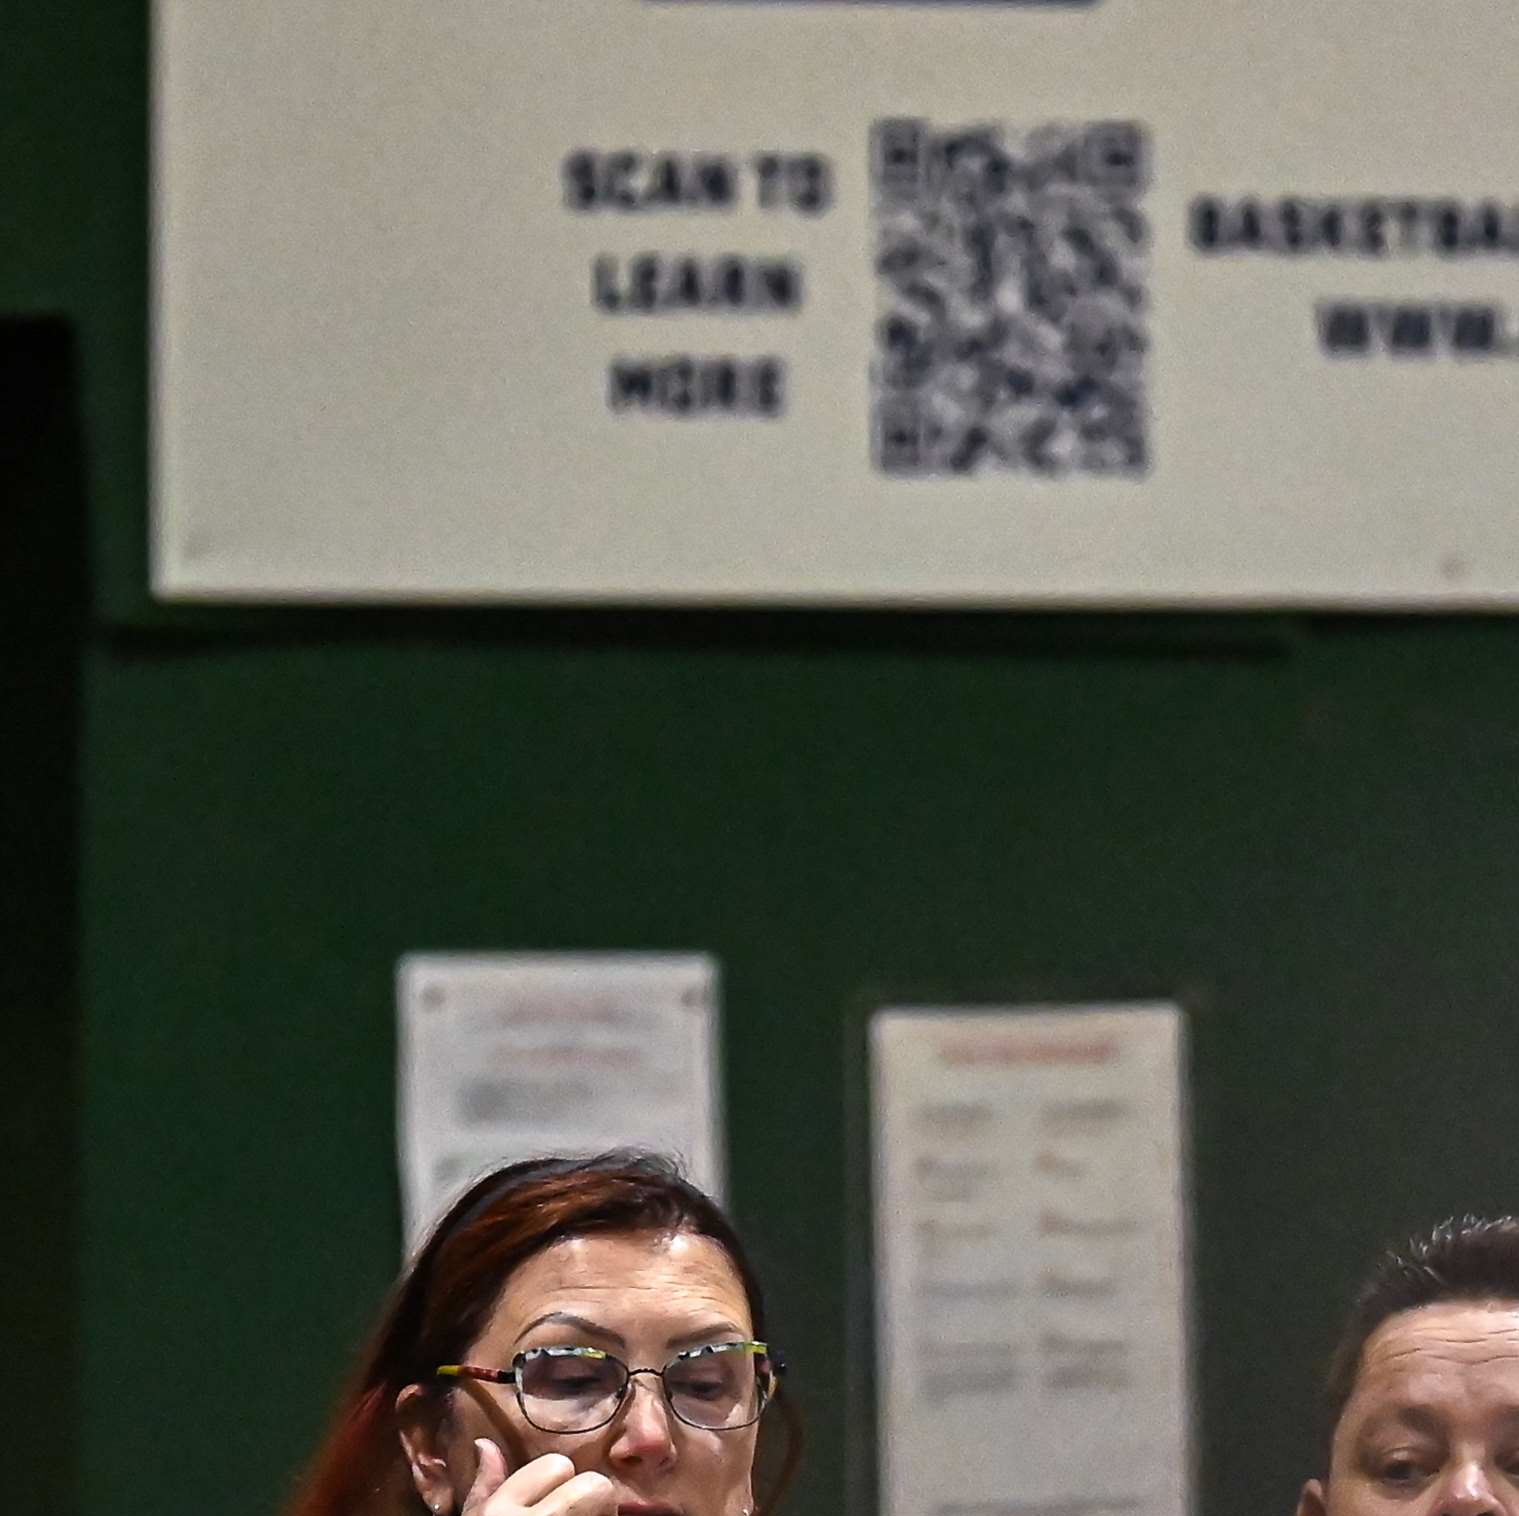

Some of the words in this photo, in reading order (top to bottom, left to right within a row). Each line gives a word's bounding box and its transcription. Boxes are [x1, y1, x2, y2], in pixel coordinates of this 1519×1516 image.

[563, 150, 737, 212] SCAN
[751, 152, 832, 216] TO
[593, 254, 801, 314] LEARN
[609, 356, 783, 417] MORE
